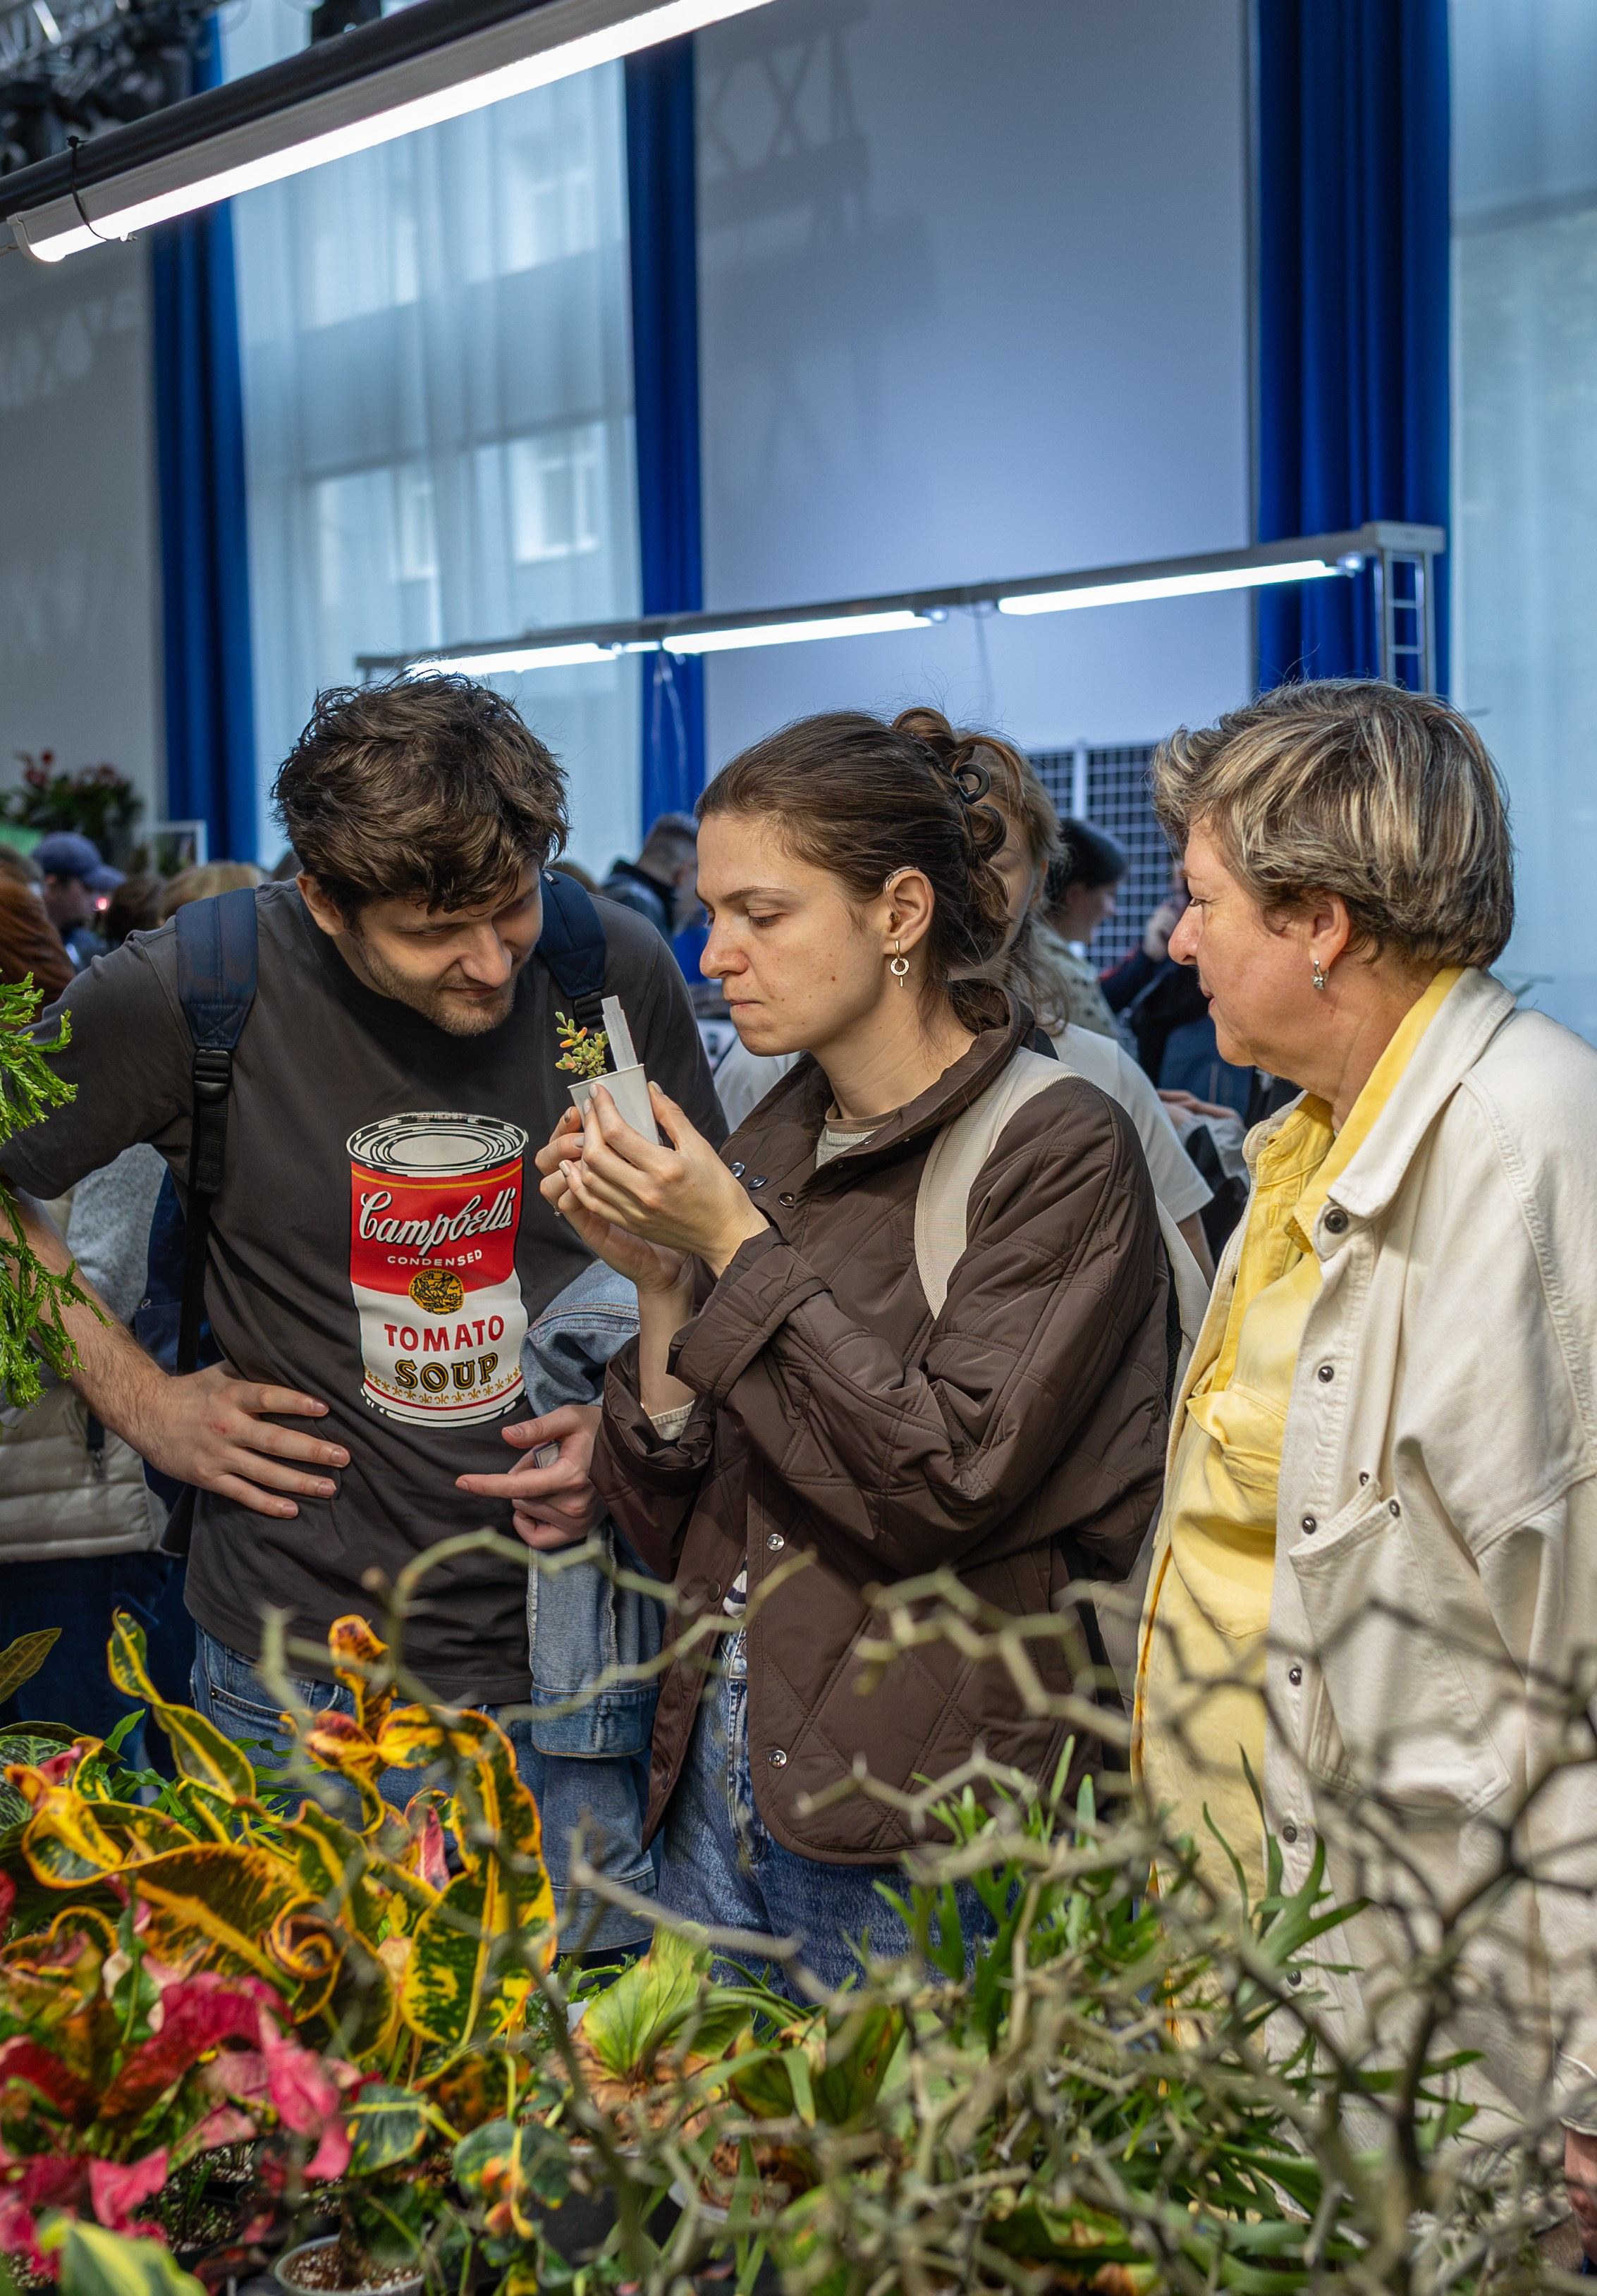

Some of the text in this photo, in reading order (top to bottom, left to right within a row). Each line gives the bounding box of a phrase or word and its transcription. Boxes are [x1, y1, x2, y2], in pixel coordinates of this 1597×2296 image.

[359, 1187, 517, 1256] Campbell's
[387, 1249, 483, 1267] CONDENSED
[384, 1315, 505, 1352] TOMATO
[395, 1351, 498, 1393] SOUP
